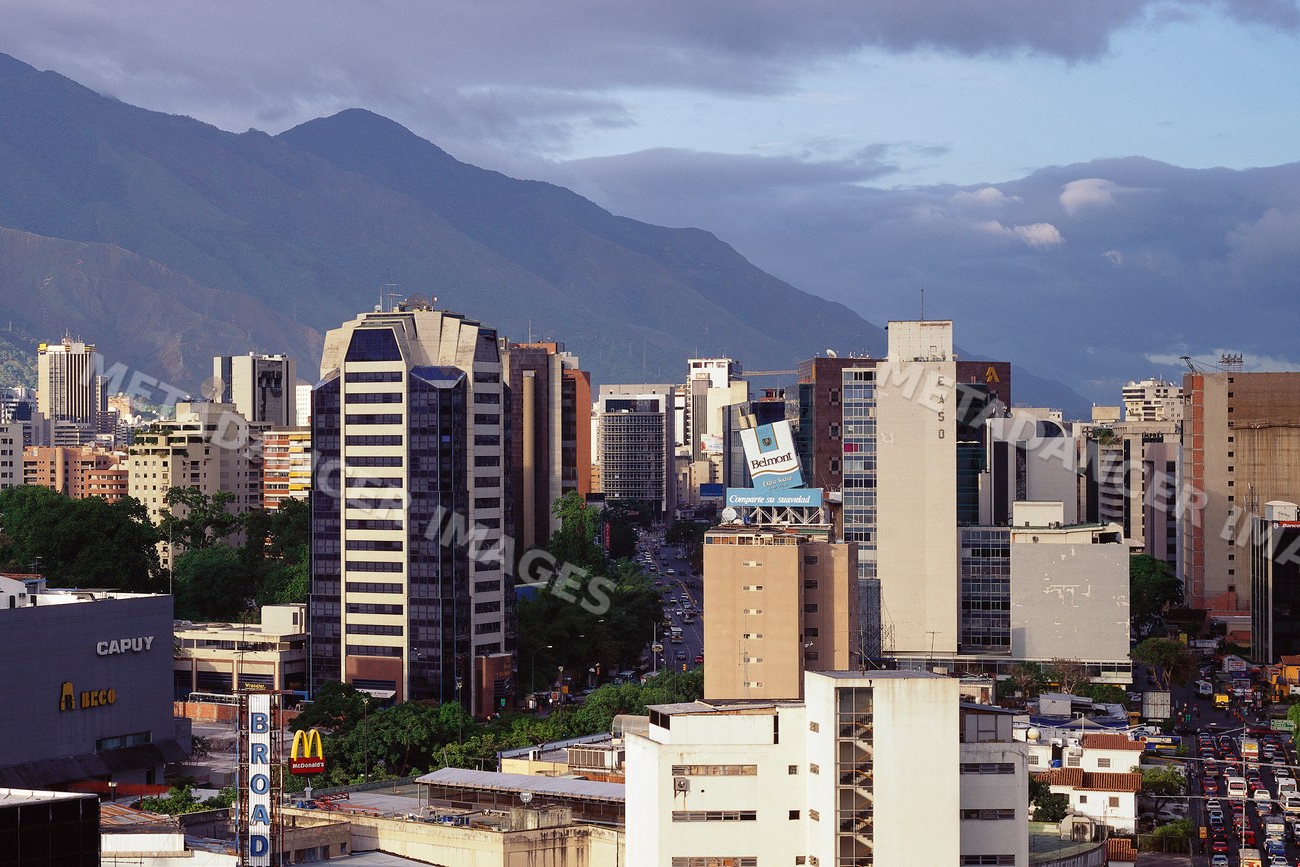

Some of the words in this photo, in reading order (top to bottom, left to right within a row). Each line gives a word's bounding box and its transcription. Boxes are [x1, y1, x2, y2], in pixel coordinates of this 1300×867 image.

[751, 452, 793, 469] Belmont
[729, 494, 764, 504] Comparte
[777, 495, 811, 504] suavidad
[96, 636, 154, 656] CAPUY
[81, 688, 116, 709] BECO
[292, 761, 325, 769] McDonald's
[250, 712, 270, 857] BROAD
